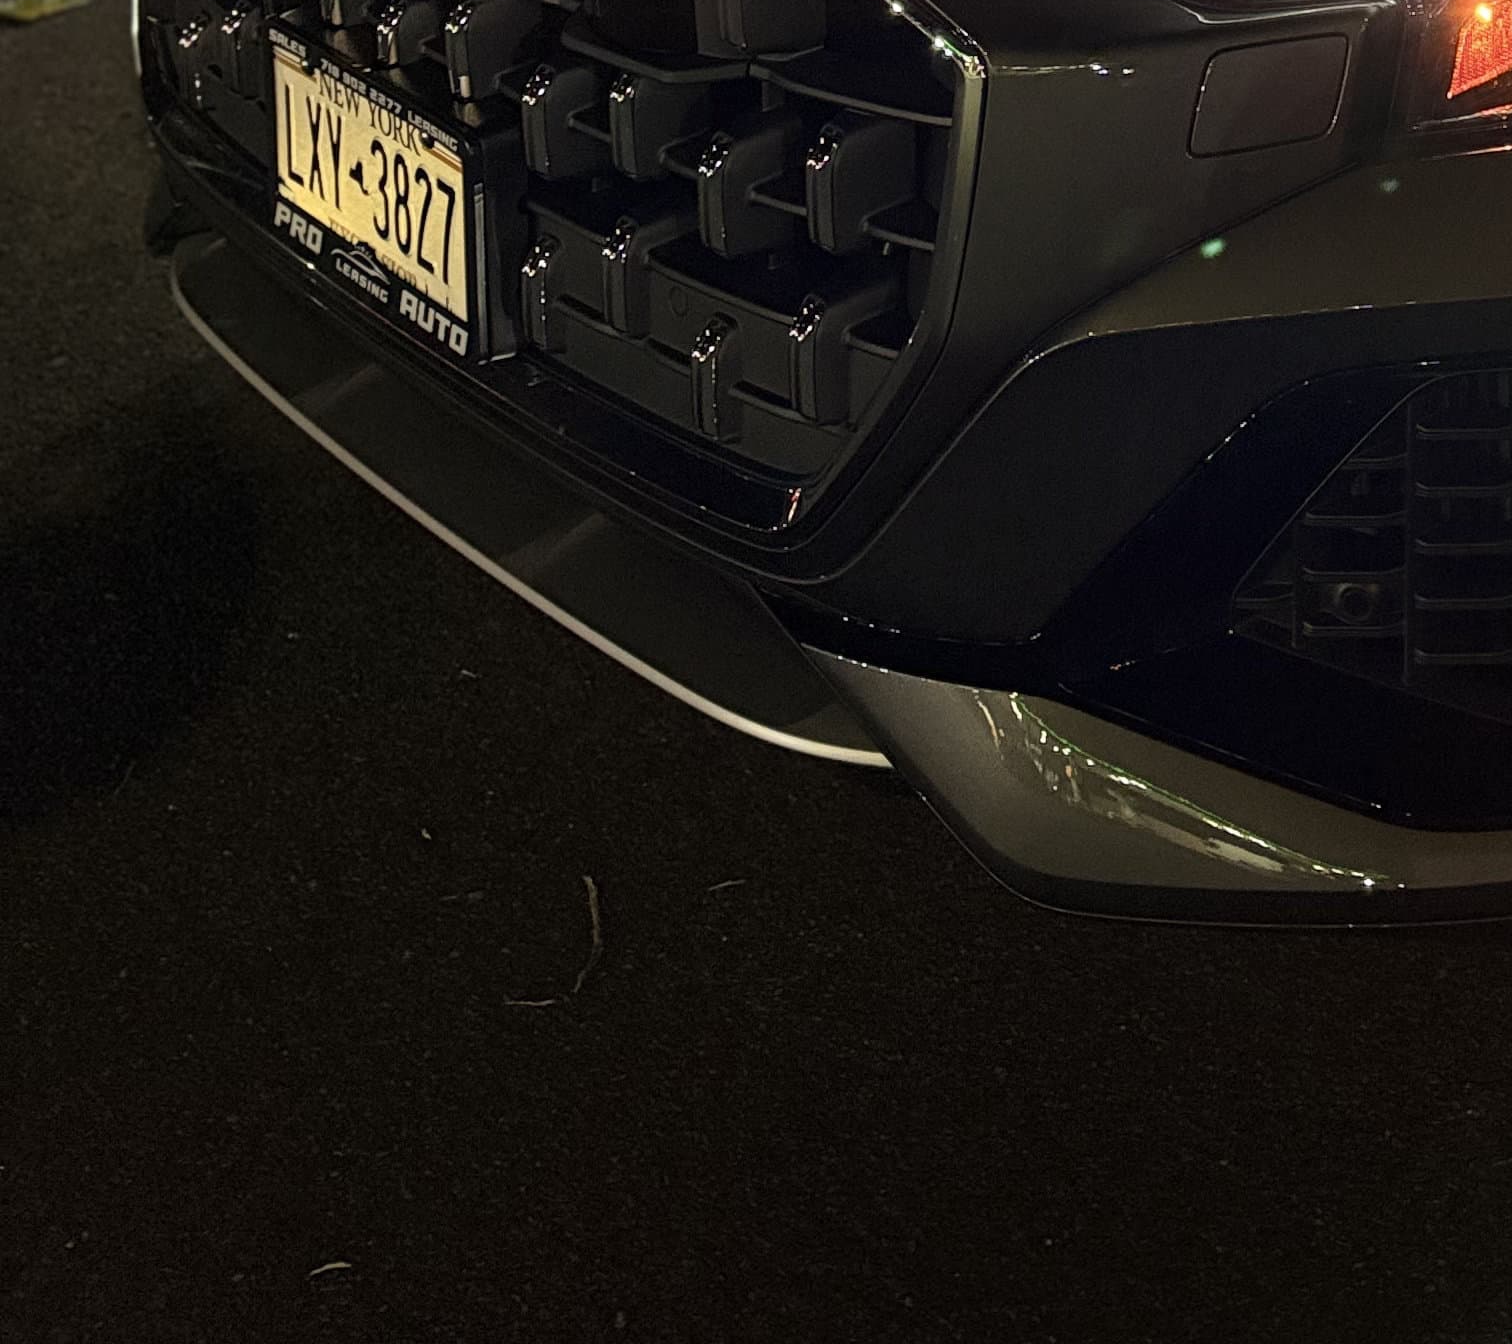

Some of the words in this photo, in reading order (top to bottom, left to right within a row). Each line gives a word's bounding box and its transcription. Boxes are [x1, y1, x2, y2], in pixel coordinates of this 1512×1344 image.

[268, 27, 307, 58] SALES
[320, 57, 340, 80] 718
[342, 70, 367, 95] 902
[369, 86, 402, 115] 2277
[407, 109, 459, 152] LEASING
[318, 71, 361, 119] NEW
[368, 100, 422, 156] YORK
[284, 81, 345, 211] LXY
[370, 136, 456, 287] 3827
[274, 200, 324, 256] PRO
[334, 256, 390, 304] LEASING
[399, 288, 469, 357] AUTO
